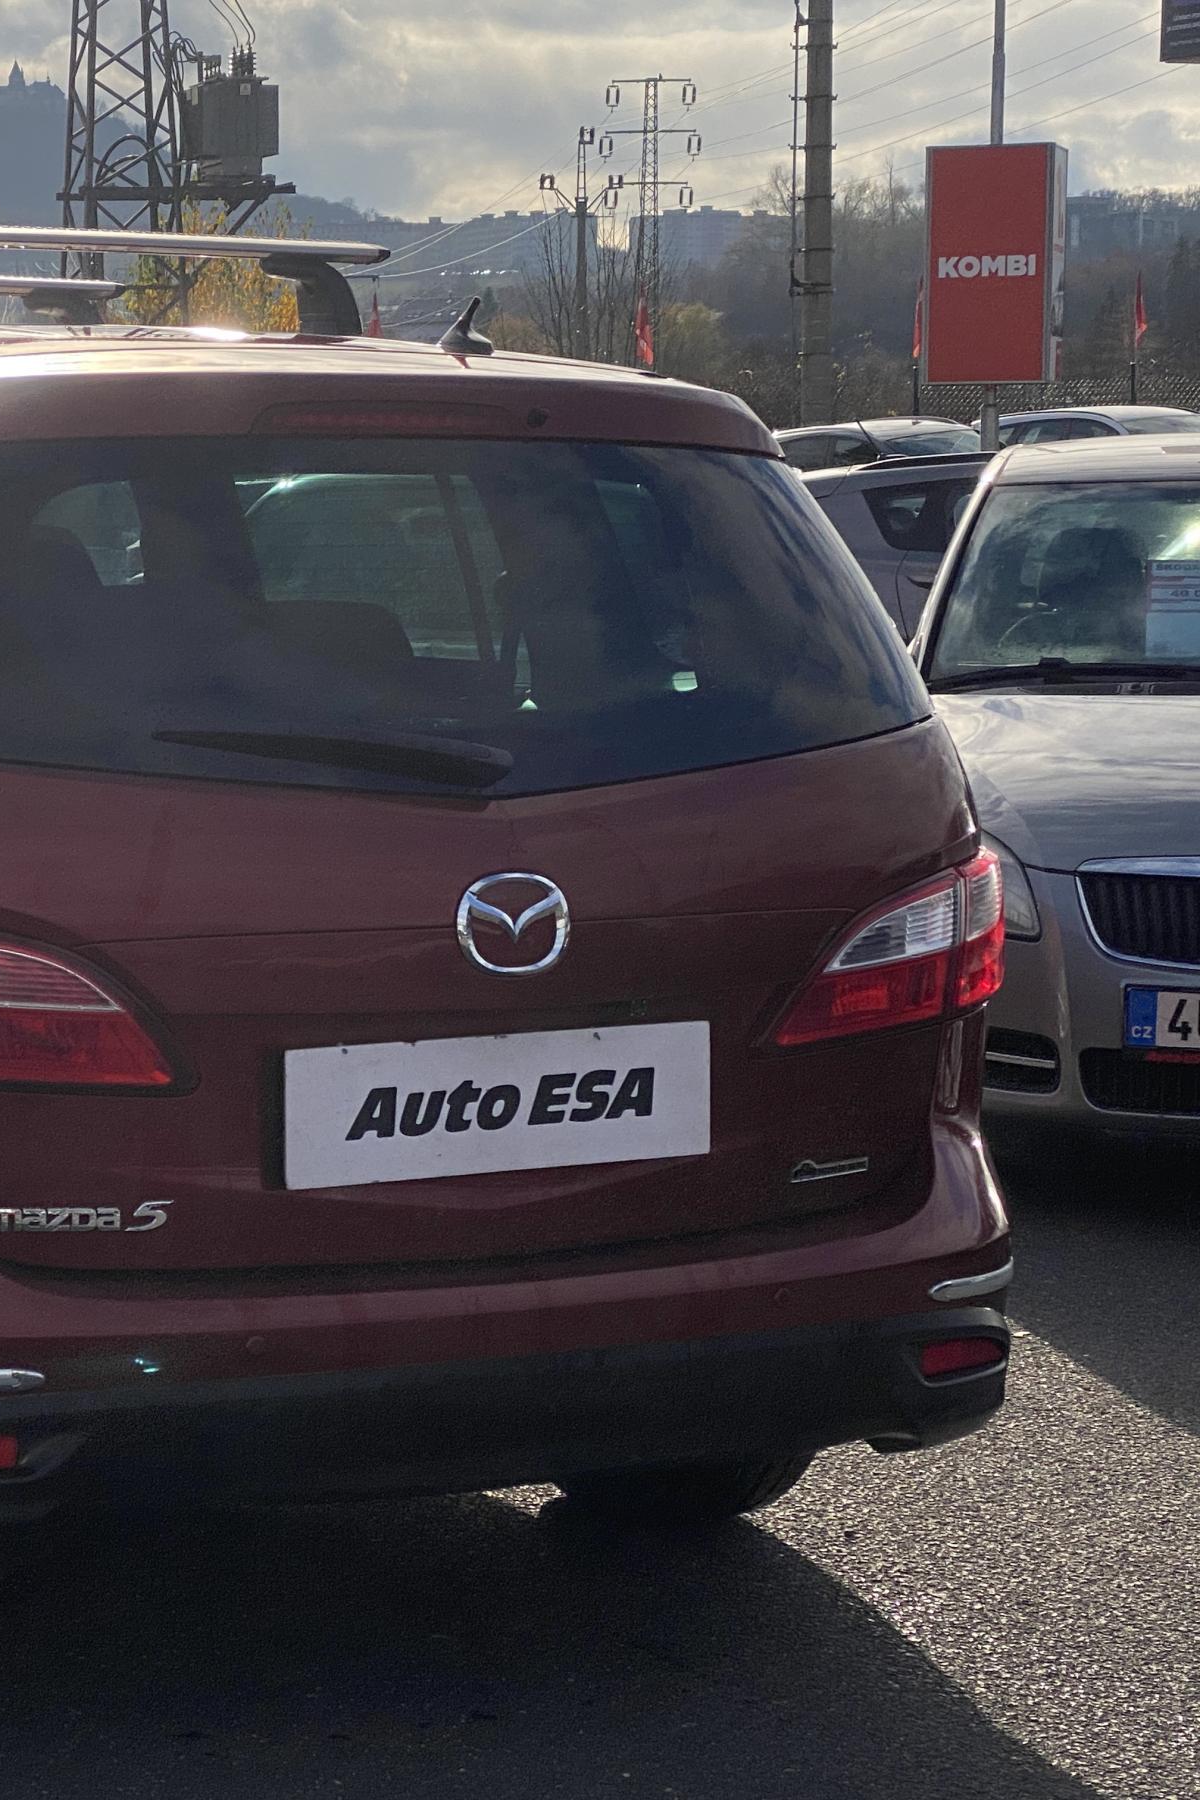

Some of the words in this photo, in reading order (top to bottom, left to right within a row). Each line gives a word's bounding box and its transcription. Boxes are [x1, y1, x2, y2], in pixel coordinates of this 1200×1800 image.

[937, 254, 1037, 279] KOMBI
[1131, 1025, 1153, 1039] CZ
[1167, 998, 1200, 1041] 4
[345, 1079, 521, 1142] Auto
[527, 1066, 656, 1126] ESA
